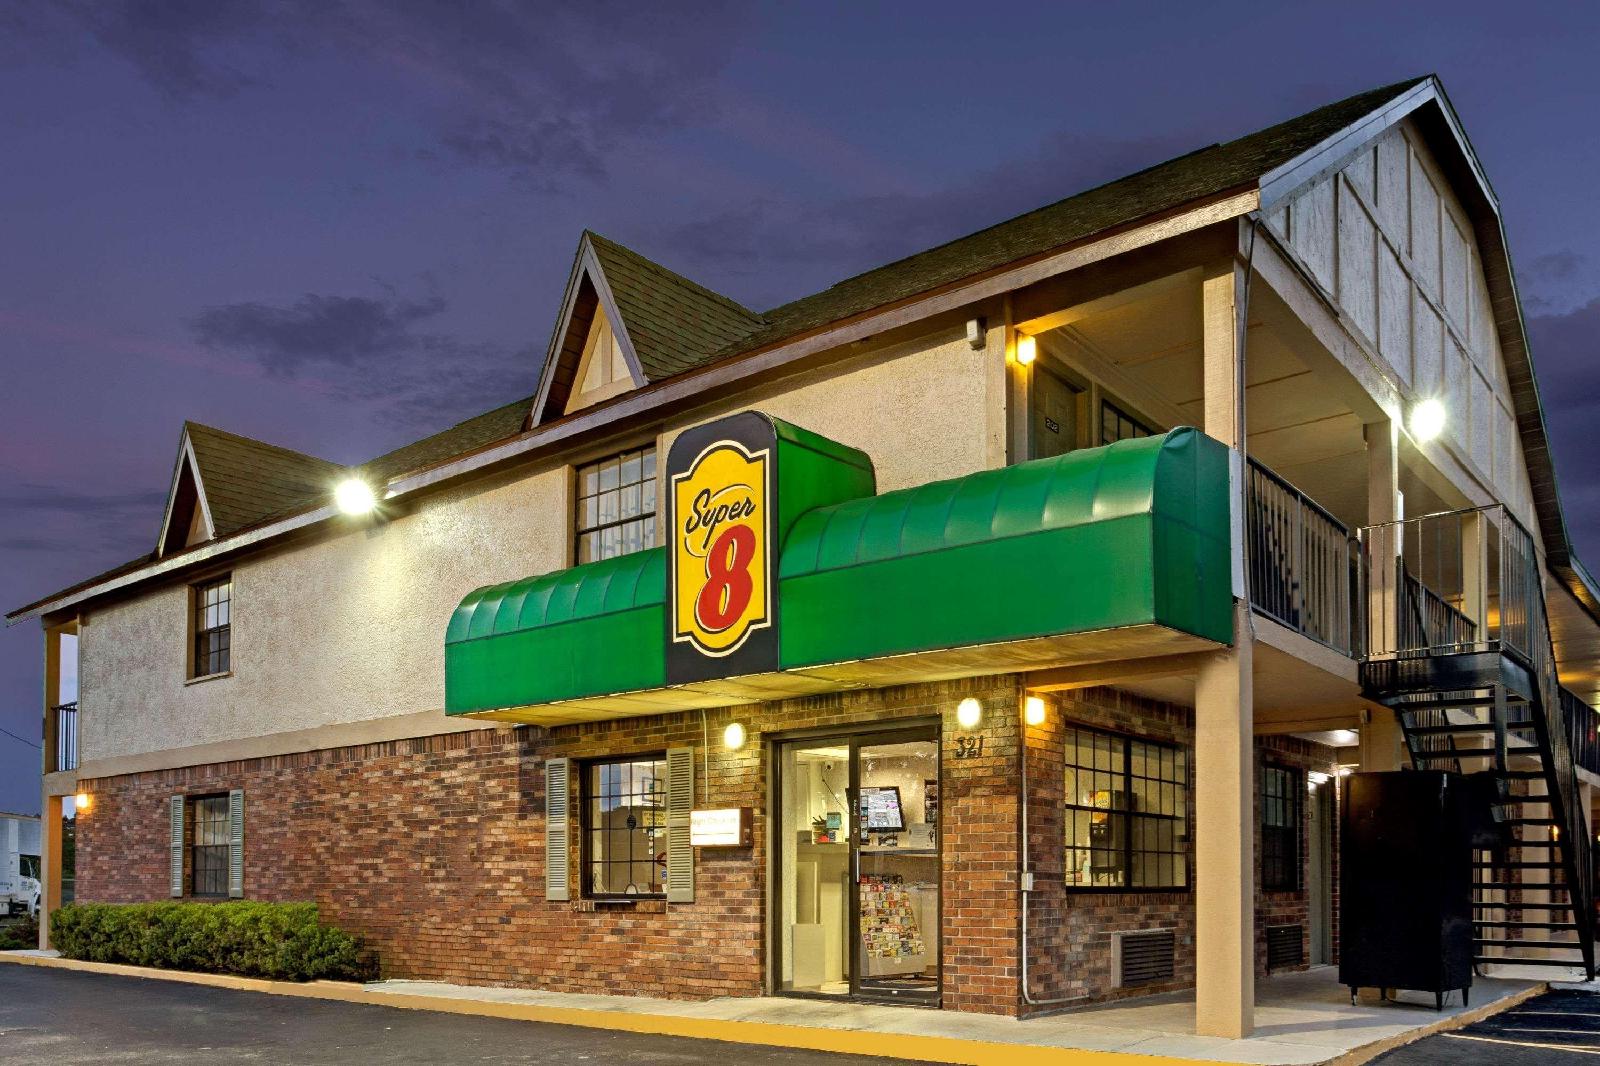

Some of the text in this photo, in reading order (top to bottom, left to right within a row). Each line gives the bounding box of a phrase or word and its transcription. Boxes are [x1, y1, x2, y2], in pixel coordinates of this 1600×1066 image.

[685, 486, 757, 552] Super
[694, 524, 757, 635] 8
[956, 735, 983, 758] 321
